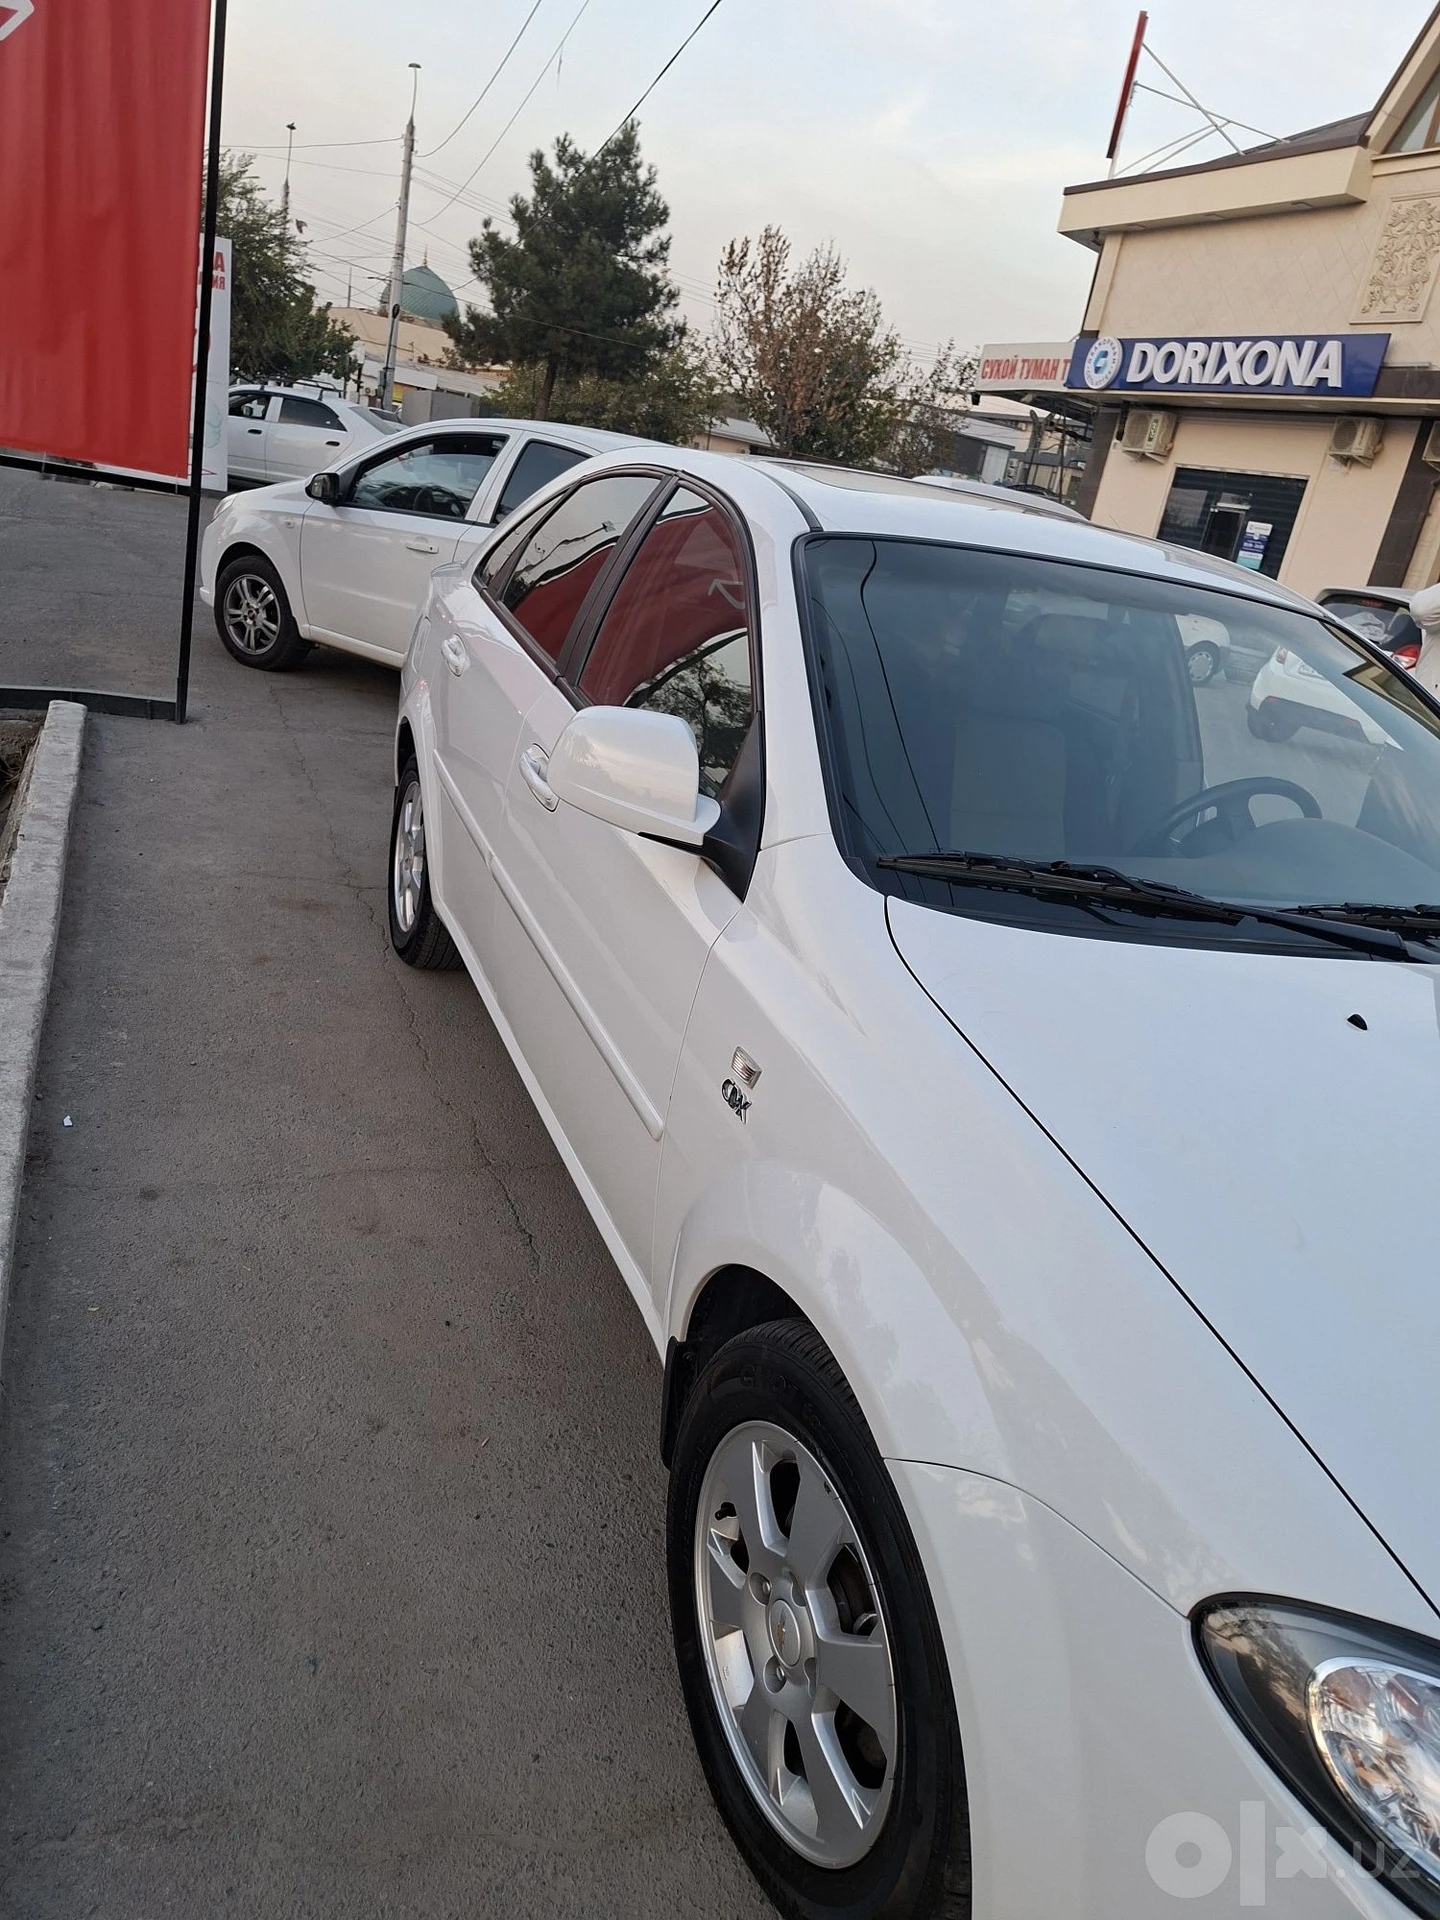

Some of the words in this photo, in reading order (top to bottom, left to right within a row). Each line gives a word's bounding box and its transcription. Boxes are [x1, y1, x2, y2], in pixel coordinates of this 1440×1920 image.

[981, 354, 1018, 380] СУХОЙ
[1019, 358, 1060, 380] ТУМАН
[1126, 341, 1343, 388] DORIXONA
